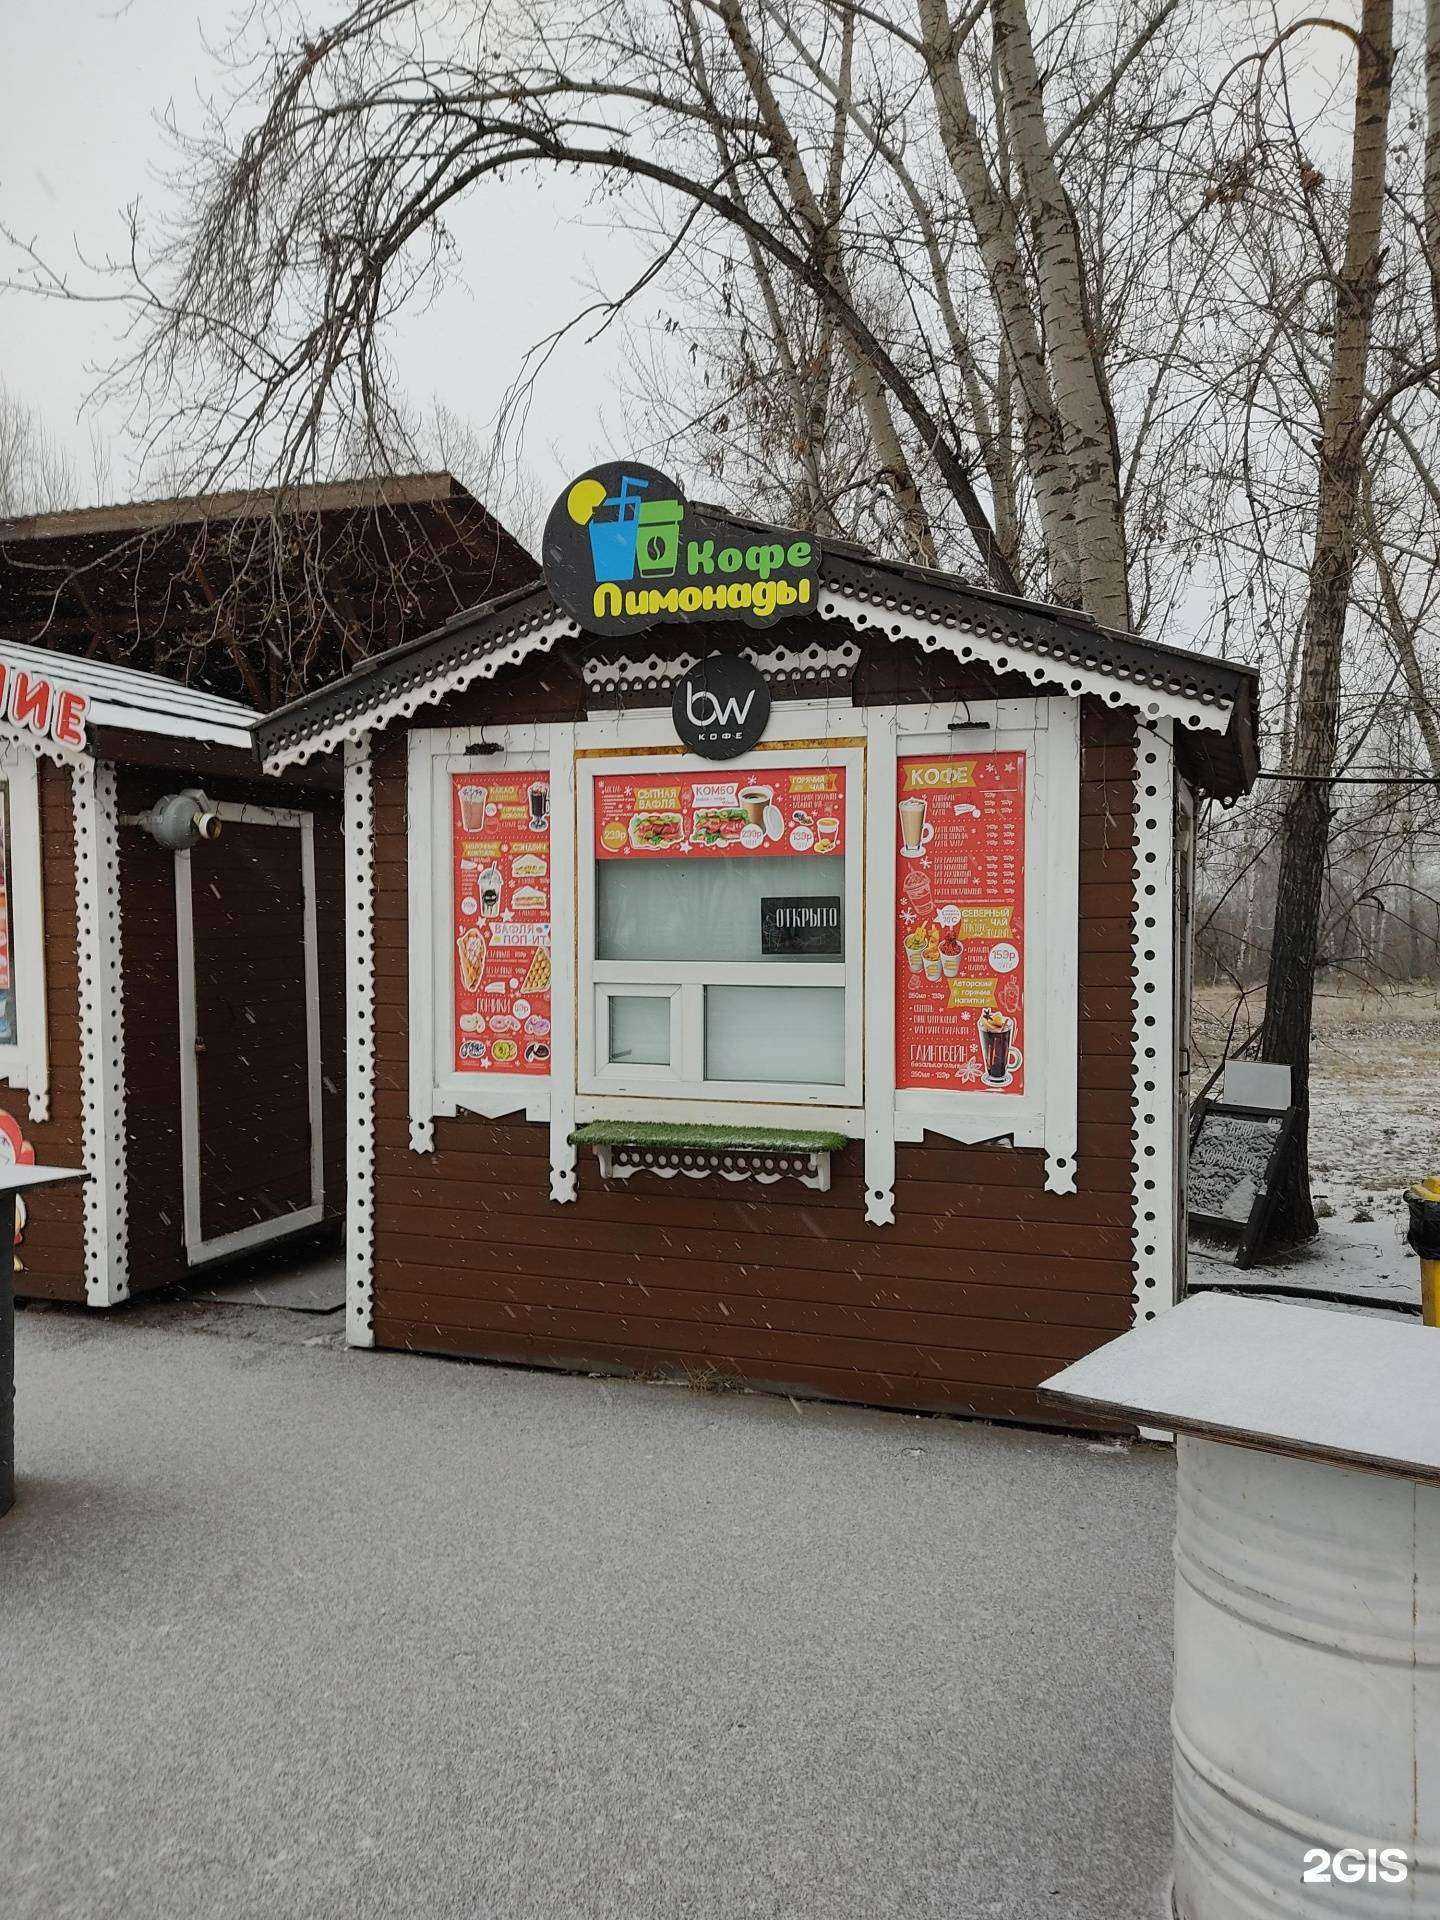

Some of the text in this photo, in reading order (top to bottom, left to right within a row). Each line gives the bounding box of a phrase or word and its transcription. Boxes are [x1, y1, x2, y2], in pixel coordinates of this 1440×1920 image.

[687, 540, 812, 579] Кофе
[698, 732, 743, 741] КОФЕ
[911, 766, 968, 785] КОФЕ
[639, 788, 677, 799] СЫТНАЯ
[696, 785, 734, 796] КОМБО
[639, 799, 676, 809] ВАФЛЯ
[776, 906, 838, 929] ОТКРЫТО
[962, 909, 1010, 919] СЕВЕРНЫЙ
[991, 918, 1008, 926] ЧАЙ
[495, 923, 536, 935] ВАФЛЯ
[503, 934, 546, 945] ПОП-ИТ
[910, 1044, 968, 1062] ГЛИНТВЕЙН
